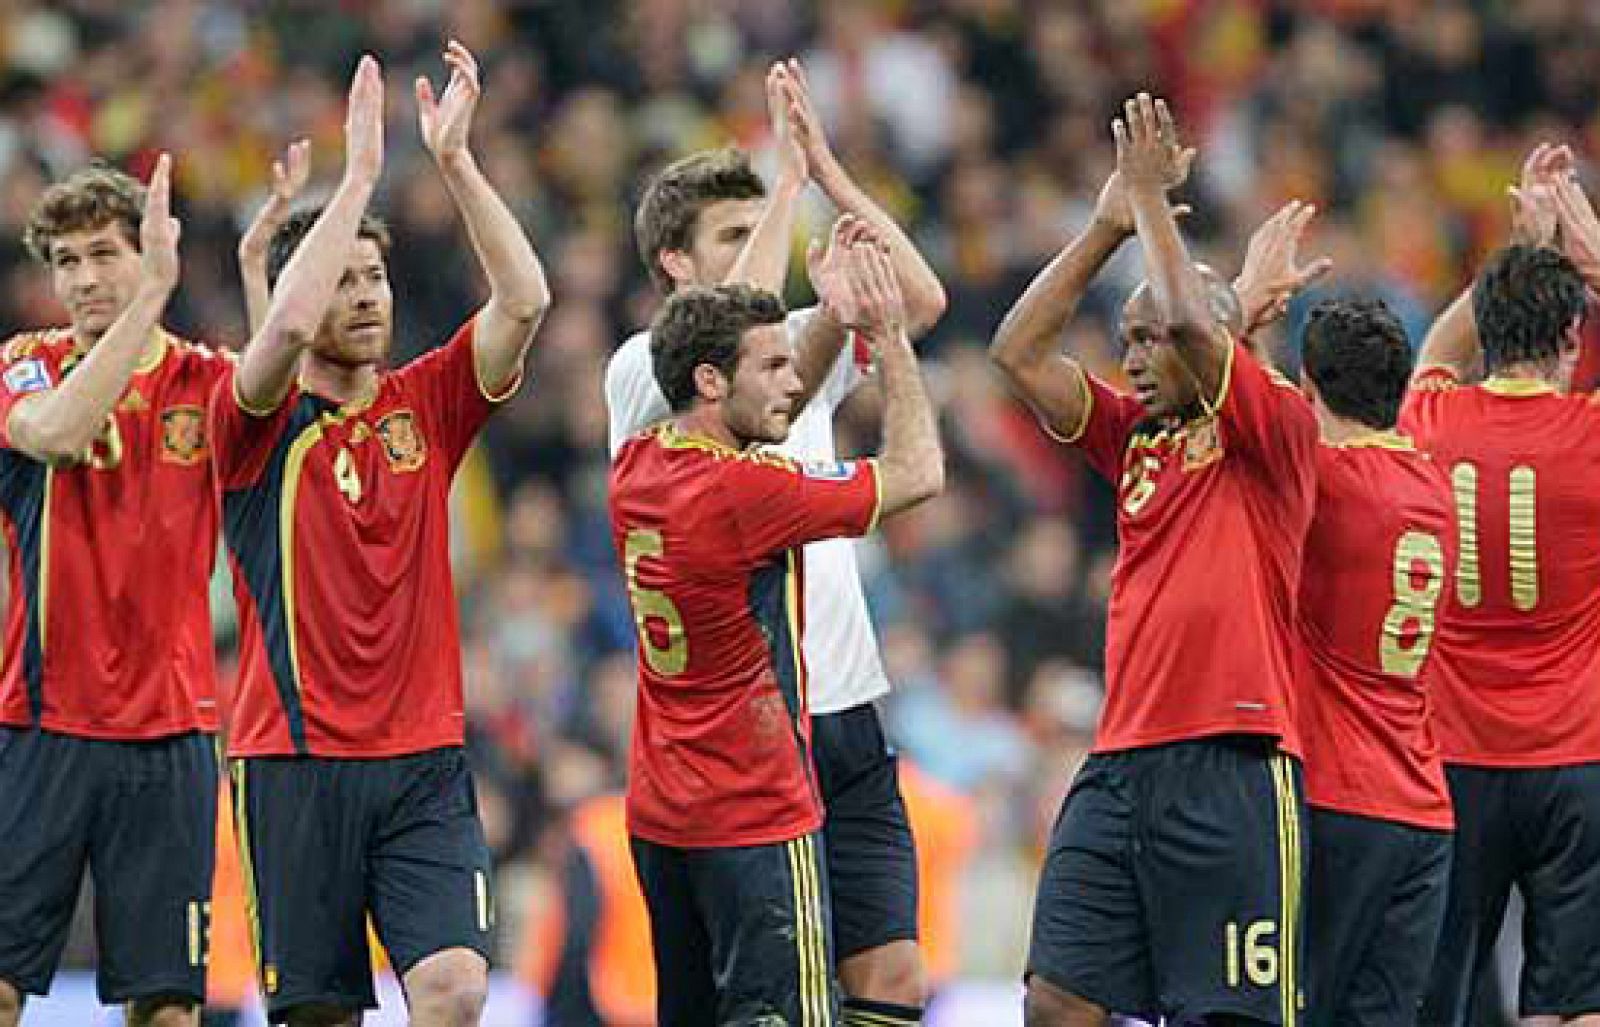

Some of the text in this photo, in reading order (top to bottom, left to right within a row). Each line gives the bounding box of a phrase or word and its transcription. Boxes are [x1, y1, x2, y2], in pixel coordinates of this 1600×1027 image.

[625, 528, 688, 677] 6
[1379, 531, 1444, 679] 8
[1451, 461, 1539, 612] 11
[1225, 920, 1278, 987] 16
